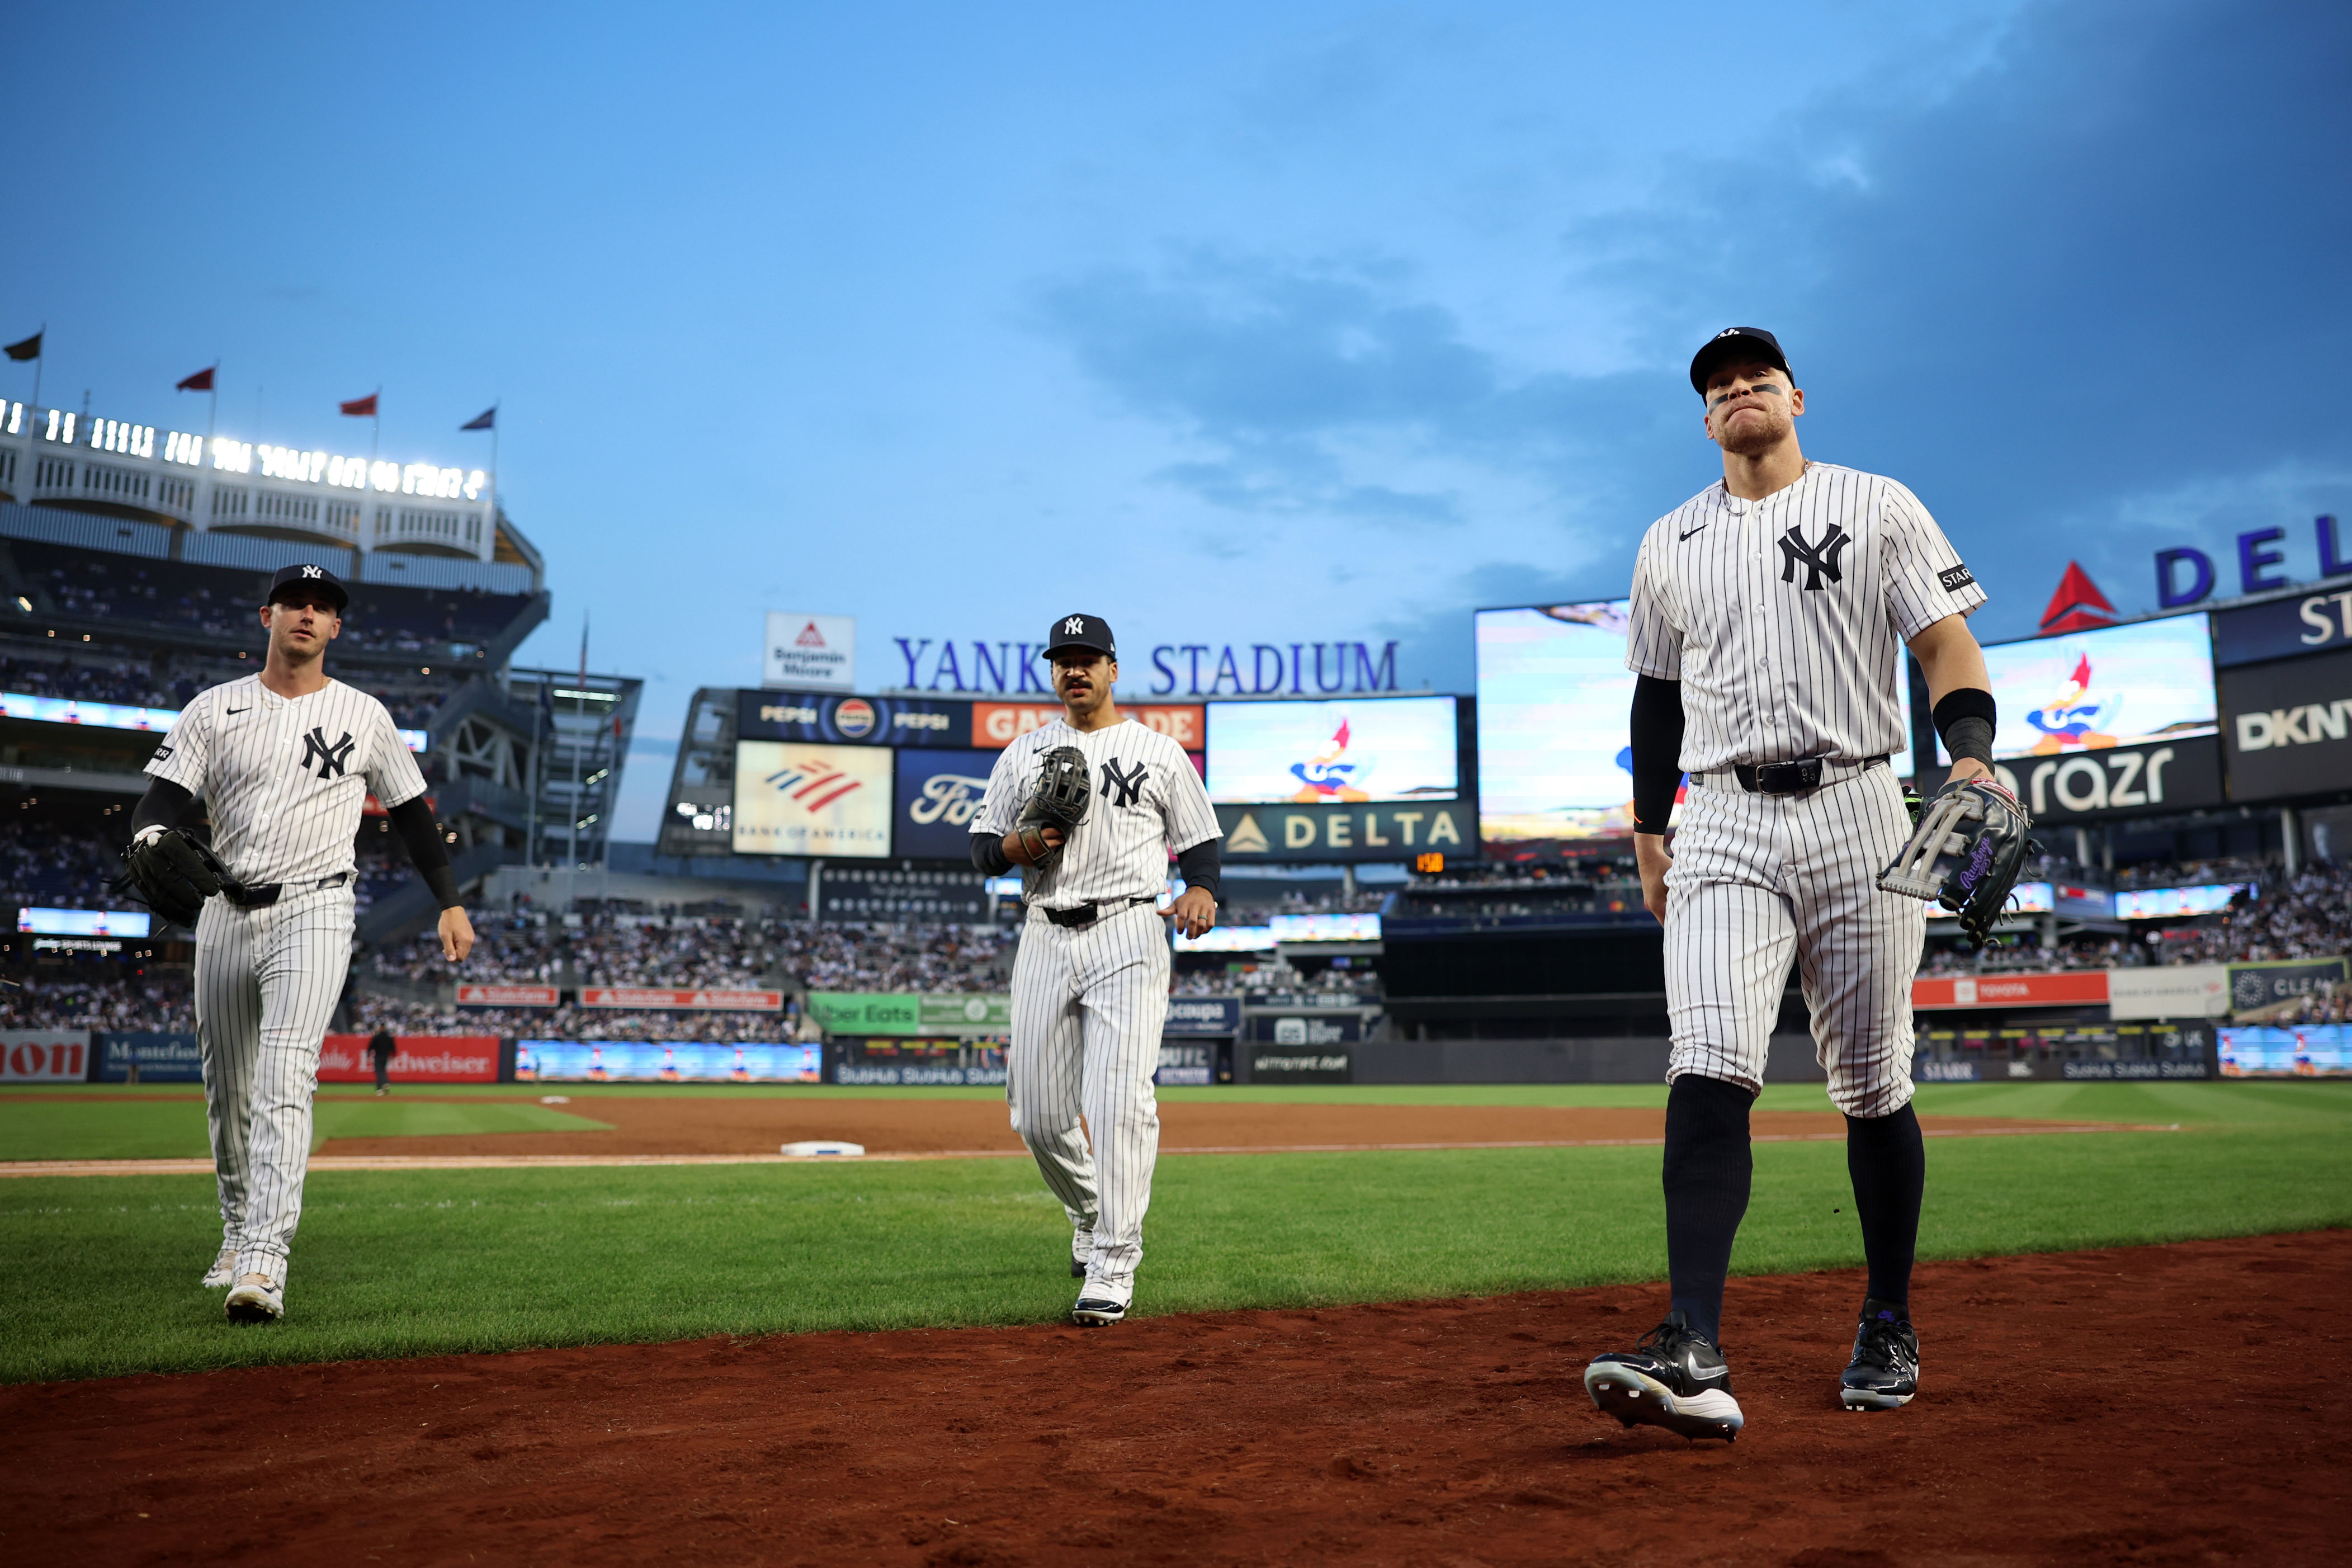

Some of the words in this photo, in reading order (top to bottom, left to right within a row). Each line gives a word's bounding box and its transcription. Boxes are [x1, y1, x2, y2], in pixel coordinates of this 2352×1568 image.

[1777, 523, 1852, 591] NY
[302, 564, 323, 579] NY
[1064, 617, 1084, 635] NY
[774, 647, 846, 663] Benjamin
[893, 636, 1049, 693] YANK
[1149, 640, 1400, 695] STADIUM
[783, 664, 833, 678] Moore
[761, 705, 818, 724] PEPSI
[894, 712, 950, 730] PEPSI
[300, 727, 355, 780] NY
[1099, 757, 1150, 807] NY
[2030, 748, 2174, 814] razr
[909, 773, 990, 826] Fo
[1285, 811, 1461, 849] DELTA
[1959, 836, 1993, 890] Rawlings
[1980, 983, 2031, 998] TOYOTA
[865, 1004, 915, 1024] Eats
[0, 1041, 83, 1077] on
[358, 1050, 490, 1074] Bdweiser
[838, 1066, 900, 1085] StubHub
[901, 1066, 964, 1085] StubHub
[966, 1066, 1008, 1085] StubH
